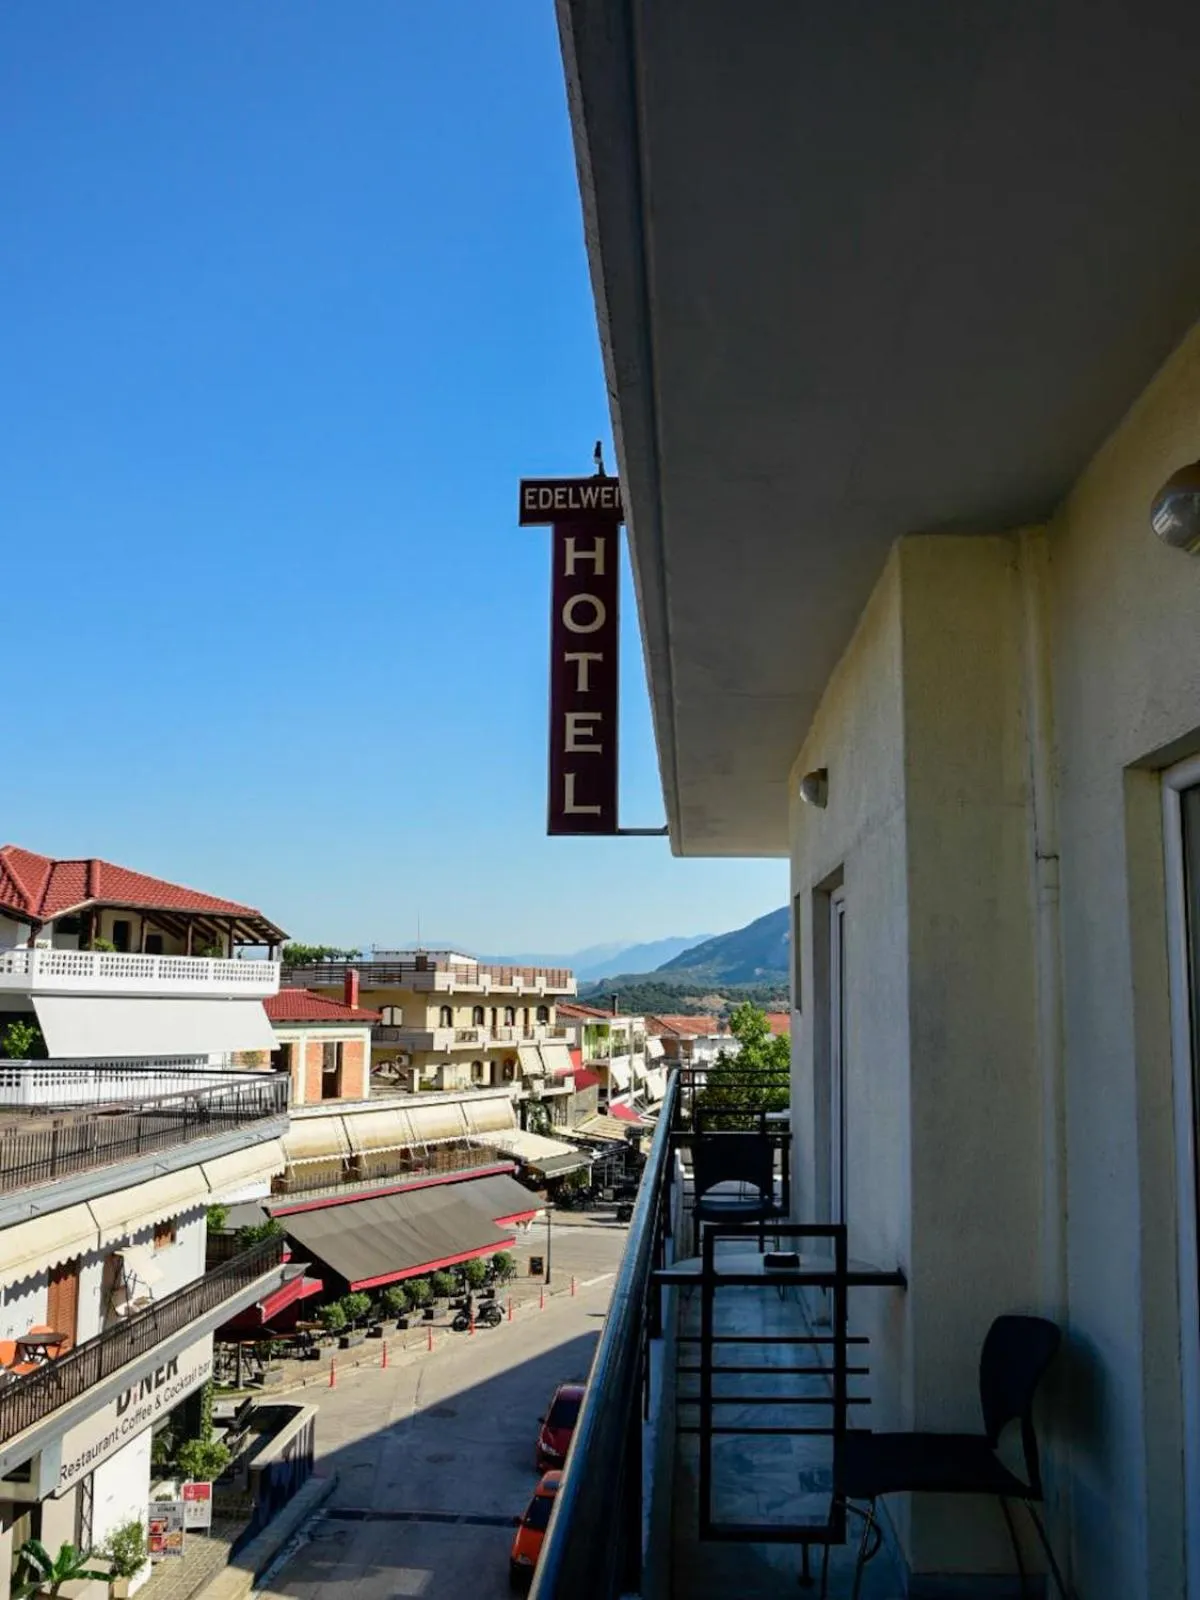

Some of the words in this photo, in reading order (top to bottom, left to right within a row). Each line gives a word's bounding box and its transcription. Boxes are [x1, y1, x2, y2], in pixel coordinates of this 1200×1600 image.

[524, 487, 620, 511] EDELWEI
[561, 536, 607, 816] HOTEL
[59, 1427, 119, 1482] Restaurant
[121, 1404, 153, 1436] Coffee
[154, 1396, 161, 1410] &
[163, 1367, 197, 1402] Cocktail
